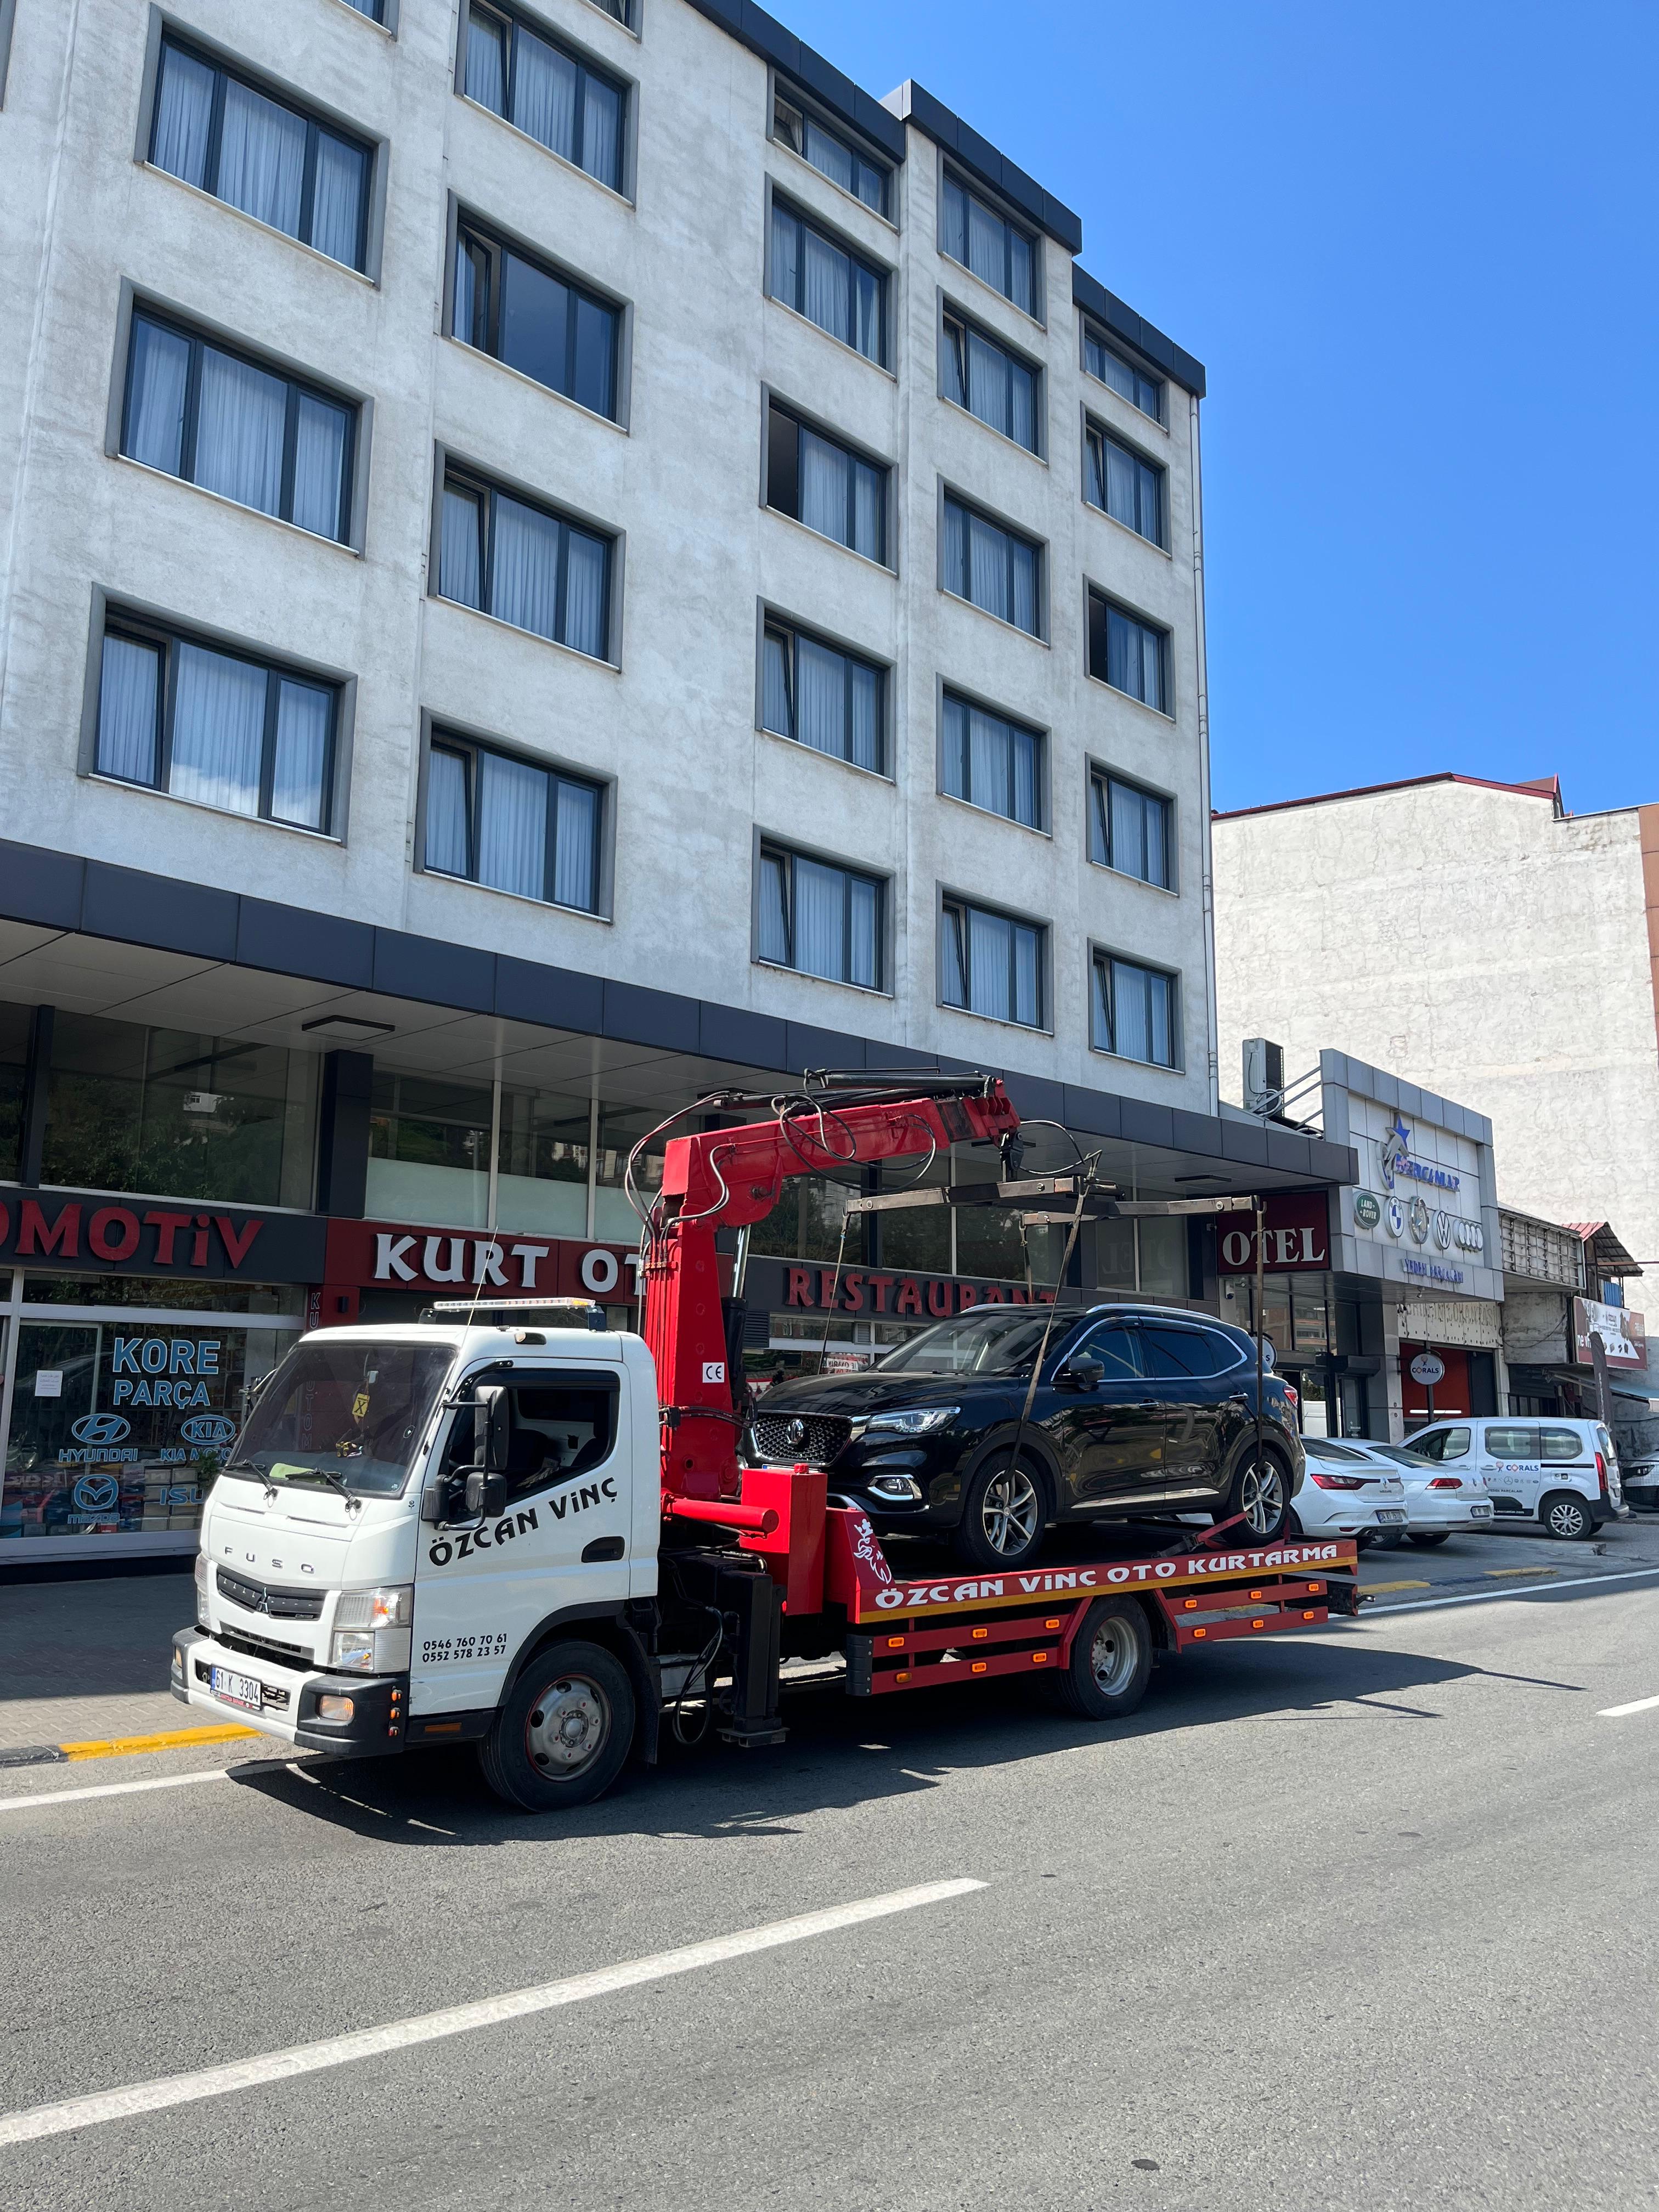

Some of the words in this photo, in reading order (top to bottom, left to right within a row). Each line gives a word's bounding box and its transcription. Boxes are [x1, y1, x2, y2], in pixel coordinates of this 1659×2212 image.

[1361, 1199, 1373, 1209] LAND
[1362, 1209, 1377, 1220] ROVER
[0, 1199, 264, 1269] MOTiV
[1222, 1227, 1325, 1266] OTEL
[373, 1233, 550, 1288] KURT
[112, 1338, 221, 1374] KORE
[706, 1365, 722, 1380] CE
[113, 1379, 211, 1409] PARÇA
[59, 1448, 138, 1462] HYUNDAI
[160, 1448, 187, 1462] KIA
[1506, 1463, 1539, 1472] CORALS
[429, 1508, 539, 1566] ÖZCAN
[224, 1546, 315, 1574] FUSO
[875, 1579, 1004, 1609] ÖZCAN
[1107, 1562, 1176, 1583] OTO
[1188, 1544, 1337, 1575] KURTARMA
[422, 1651, 449, 1663] 0552
[454, 1648, 472, 1660] 578
[477, 1646, 490, 1657] 23
[494, 1645, 506, 1655] 57
[423, 1639, 452, 1651] 0546
[456, 1637, 476, 1647] 760
[480, 1635, 493, 1645] 70
[496, 1633, 507, 1643] 61
[216, 1669, 224, 1690] 61
[228, 1674, 233, 1693] K
[239, 1678, 258, 1703] 3304
